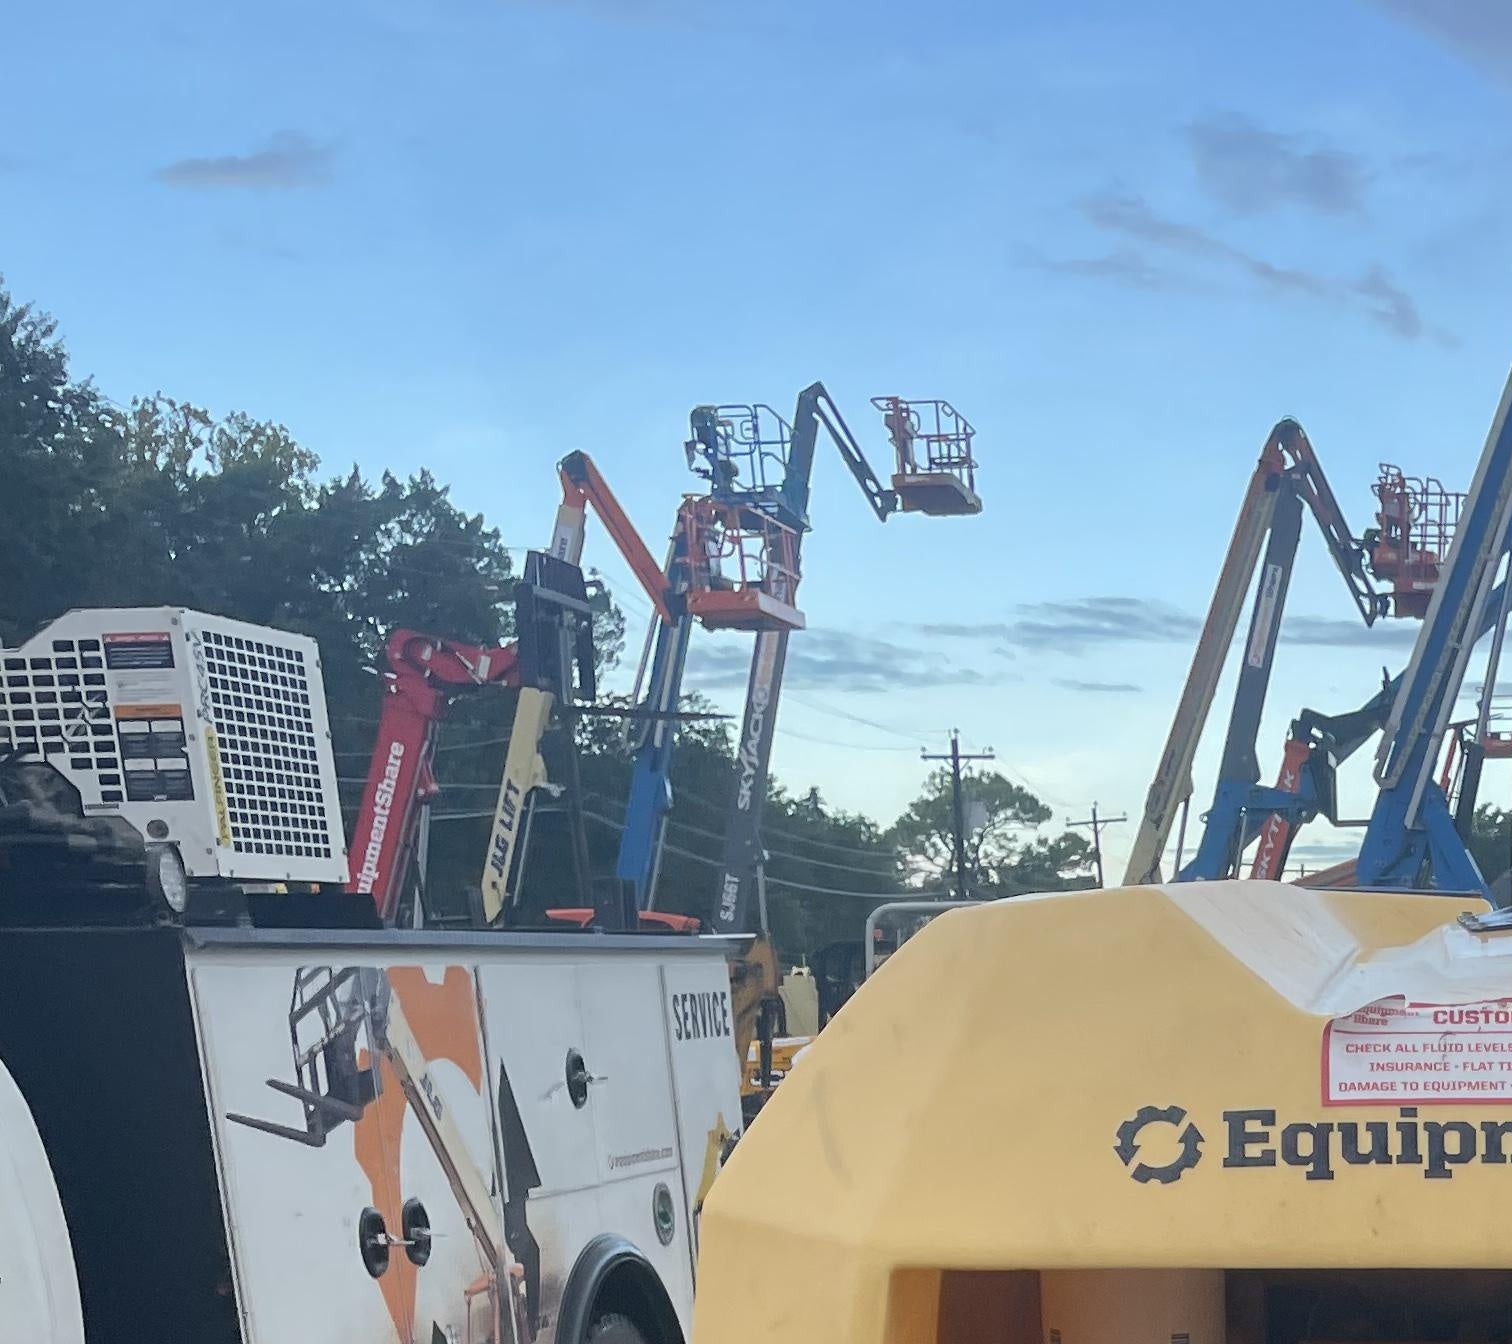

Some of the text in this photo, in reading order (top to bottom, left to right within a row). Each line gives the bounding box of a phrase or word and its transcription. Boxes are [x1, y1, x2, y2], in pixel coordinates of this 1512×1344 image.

[357, 741, 405, 894] uipmentShare
[672, 991, 730, 1041] SERVICE
[1345, 1043, 1391, 1053] CHECK
[1394, 1043, 1419, 1053] ALL
[1422, 1042, 1464, 1053] FLUID
[1369, 1061, 1450, 1072] INSURANCE
[1462, 1061, 1494, 1072] FLAT
[1338, 1081, 1398, 1092] DAMAGE
[1402, 1081, 1419, 1091] TO
[1423, 1080, 1508, 1092] EQUIPMENT
